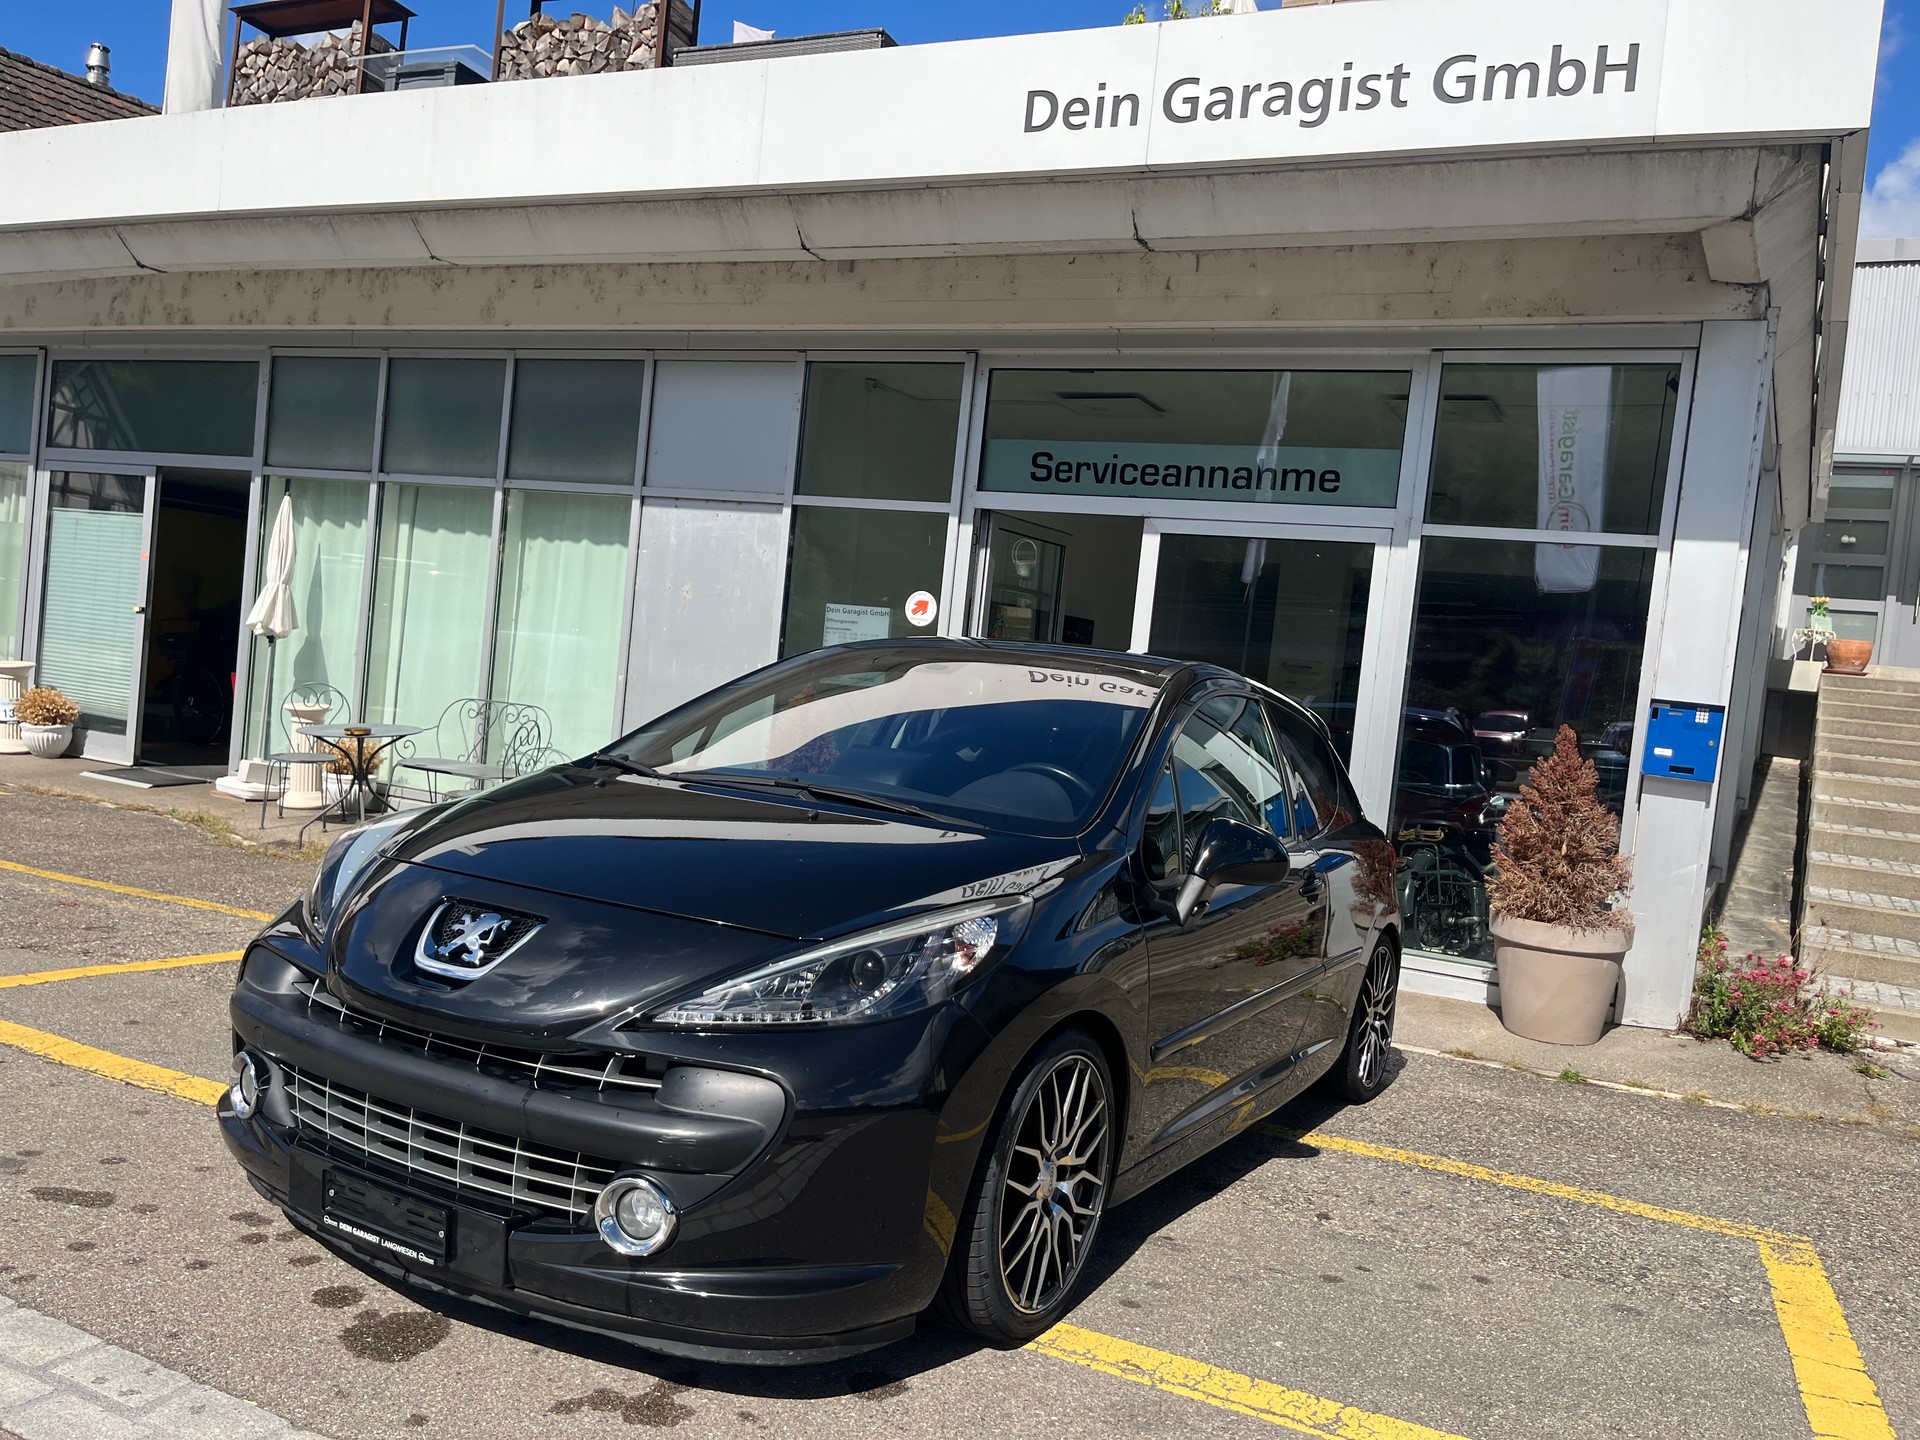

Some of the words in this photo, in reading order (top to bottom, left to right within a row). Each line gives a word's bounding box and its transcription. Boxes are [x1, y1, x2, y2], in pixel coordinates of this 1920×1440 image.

[1023, 82, 1140, 133] Dein
[1162, 61, 1411, 129] Garagist
[1432, 42, 1640, 105] GmbH
[1029, 451, 1342, 494] Serviceannahme
[842, 607, 868, 616] Garagist
[869, 609, 889, 617] GmbH
[339, 1221, 353, 1233] DEIN
[353, 1227, 380, 1244] GARAGIST
[381, 1238, 418, 1259] LANGWIESEN
